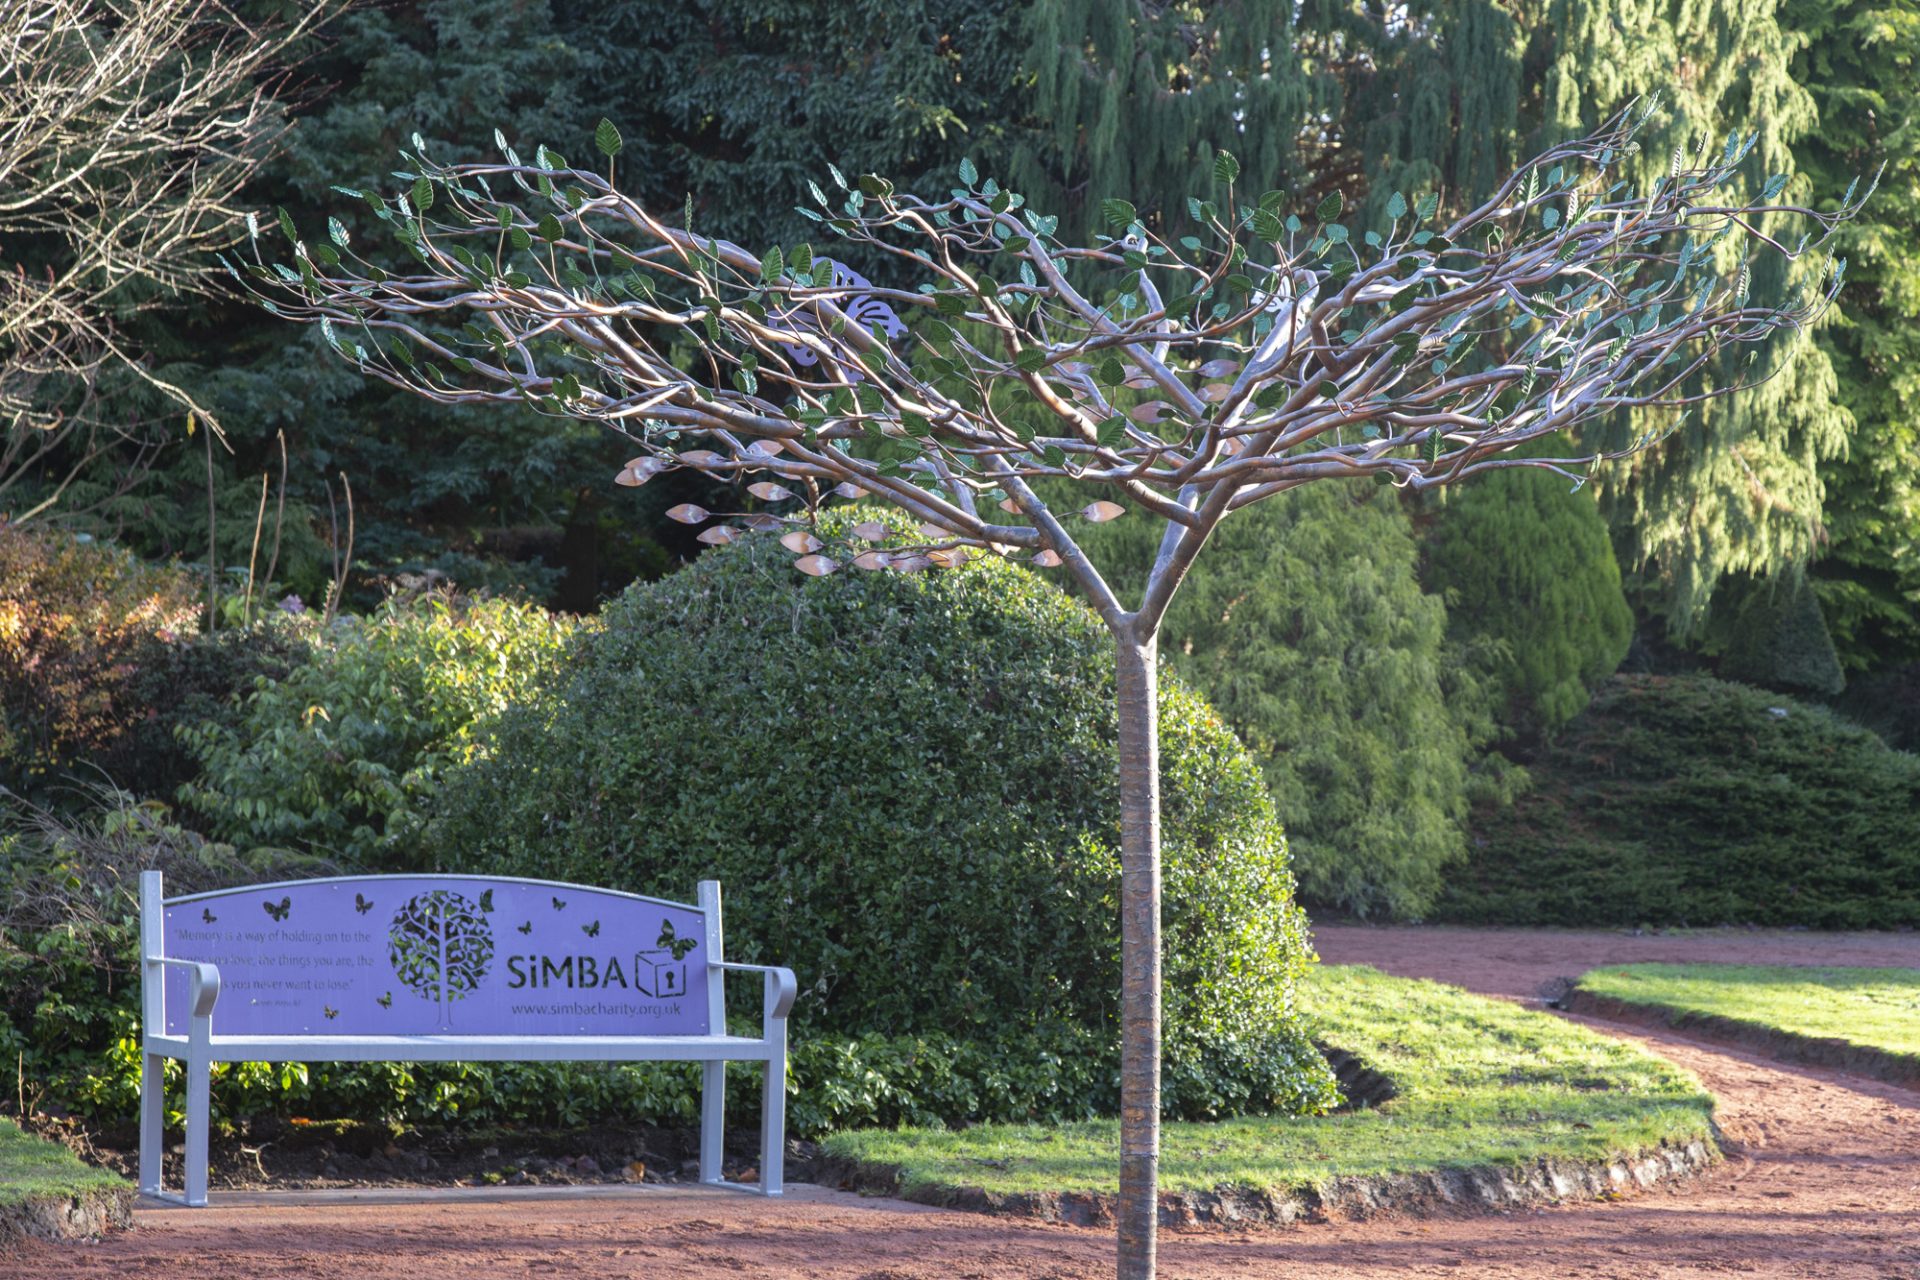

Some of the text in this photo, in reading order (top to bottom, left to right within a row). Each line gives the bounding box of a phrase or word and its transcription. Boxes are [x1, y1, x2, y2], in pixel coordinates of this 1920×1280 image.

[236, 932, 242, 941] a
[244, 932, 266, 943] way
[268, 929, 279, 941] of
[281, 929, 322, 945] holding
[324, 932, 338, 942] on
[341, 931, 352, 942] to
[354, 930, 372, 942] the
[258, 954, 276, 966] the
[278, 953, 311, 969] things
[313, 956, 333, 968] you
[335, 956, 355, 968] are,
[357, 954, 375, 967] the
[507, 955, 628, 989] SiMBA
[231, 981, 251, 991] you
[253, 980, 282, 990] never
[285, 979, 311, 990] want
[314, 979, 325, 990] to
[511, 1001, 681, 1018] www.simbacharity.org.uk
